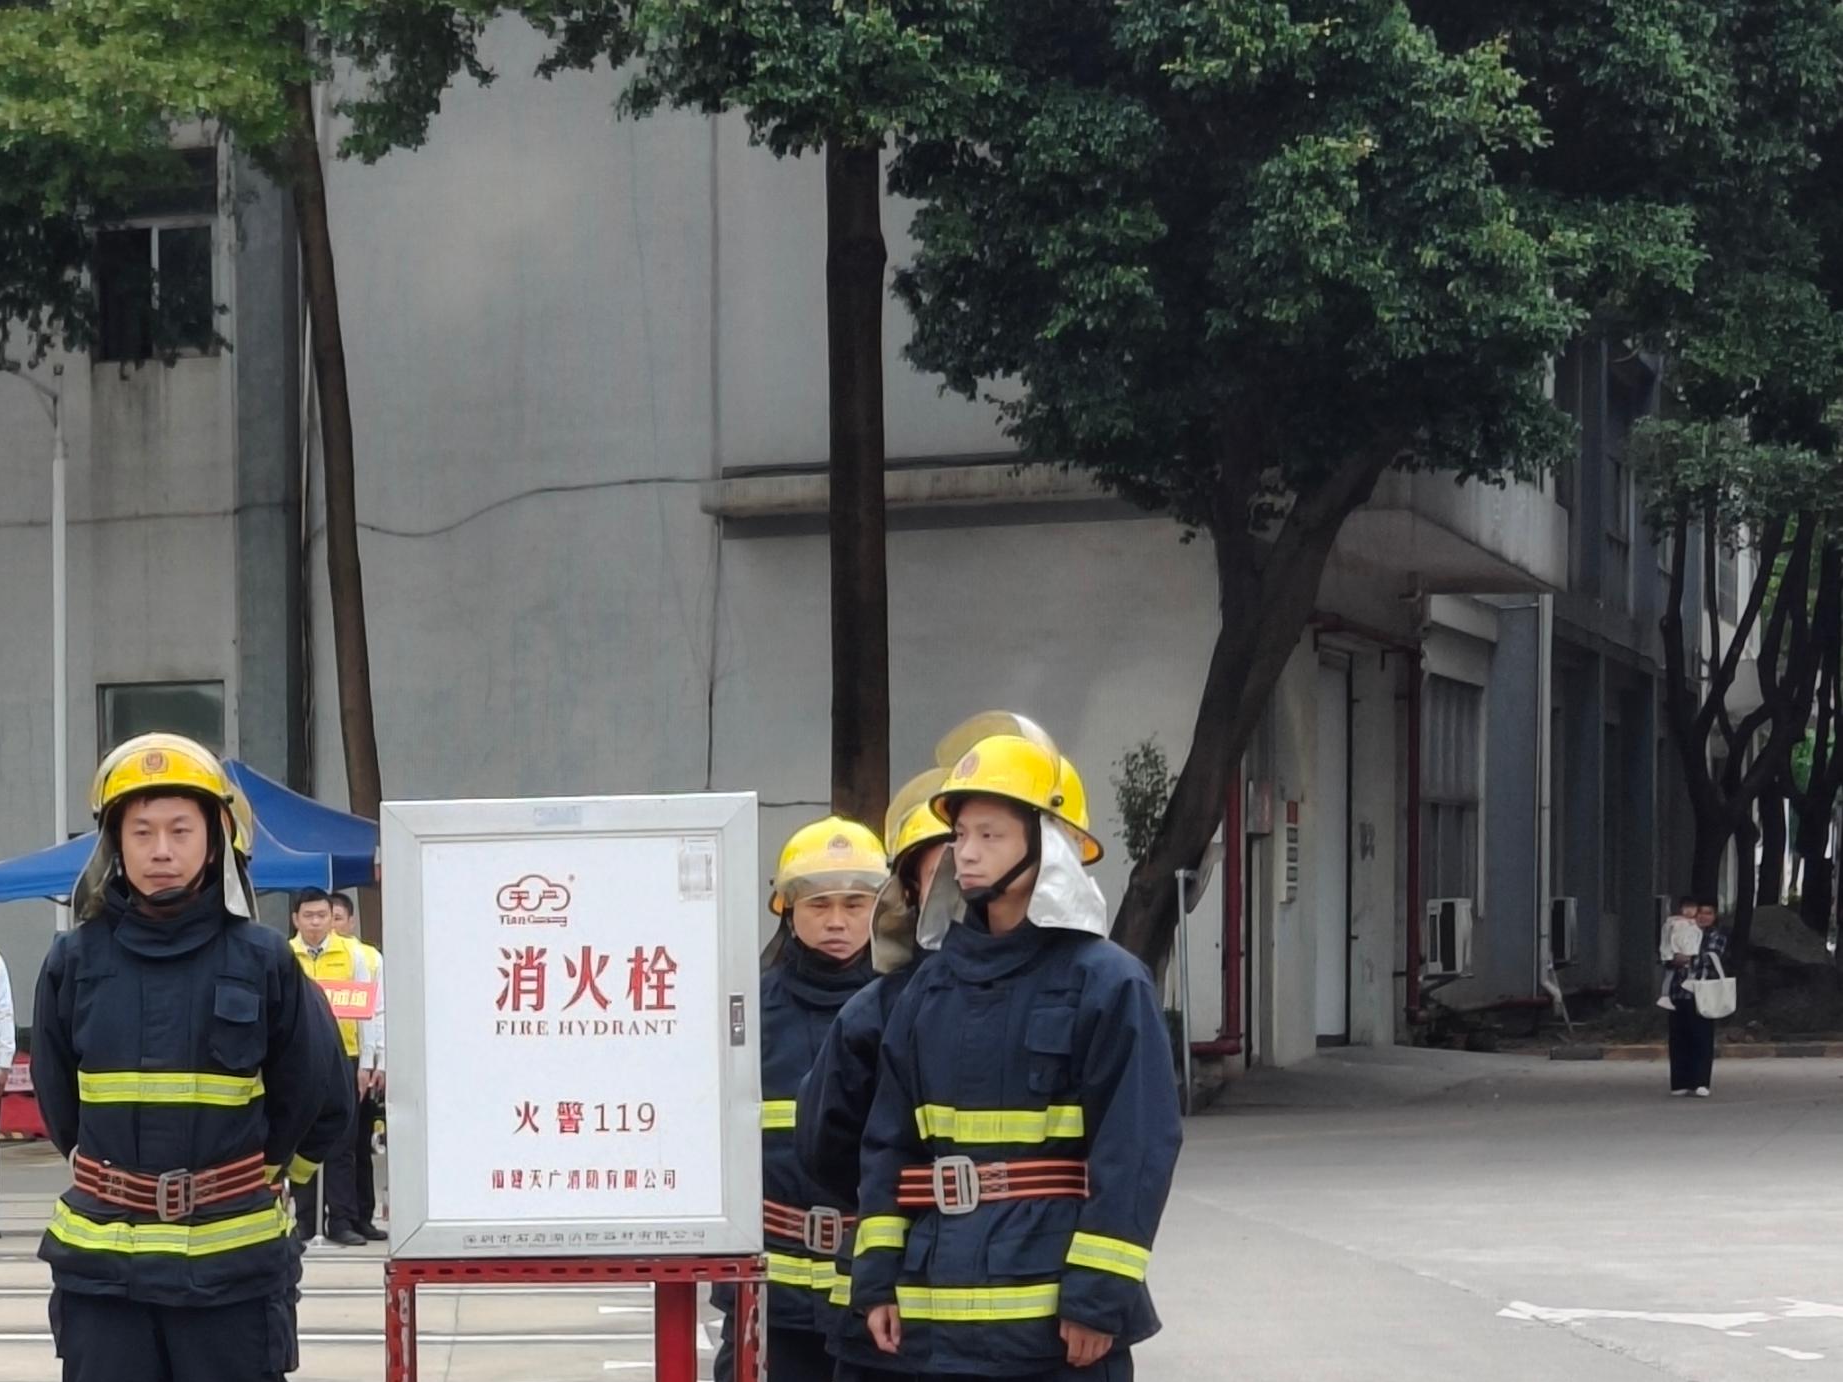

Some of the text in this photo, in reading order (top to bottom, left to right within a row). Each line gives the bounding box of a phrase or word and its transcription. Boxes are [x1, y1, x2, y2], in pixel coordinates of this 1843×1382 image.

[495, 945, 678, 1012] 消火栓
[495, 1019, 678, 1036] FIRE HYDRANT
